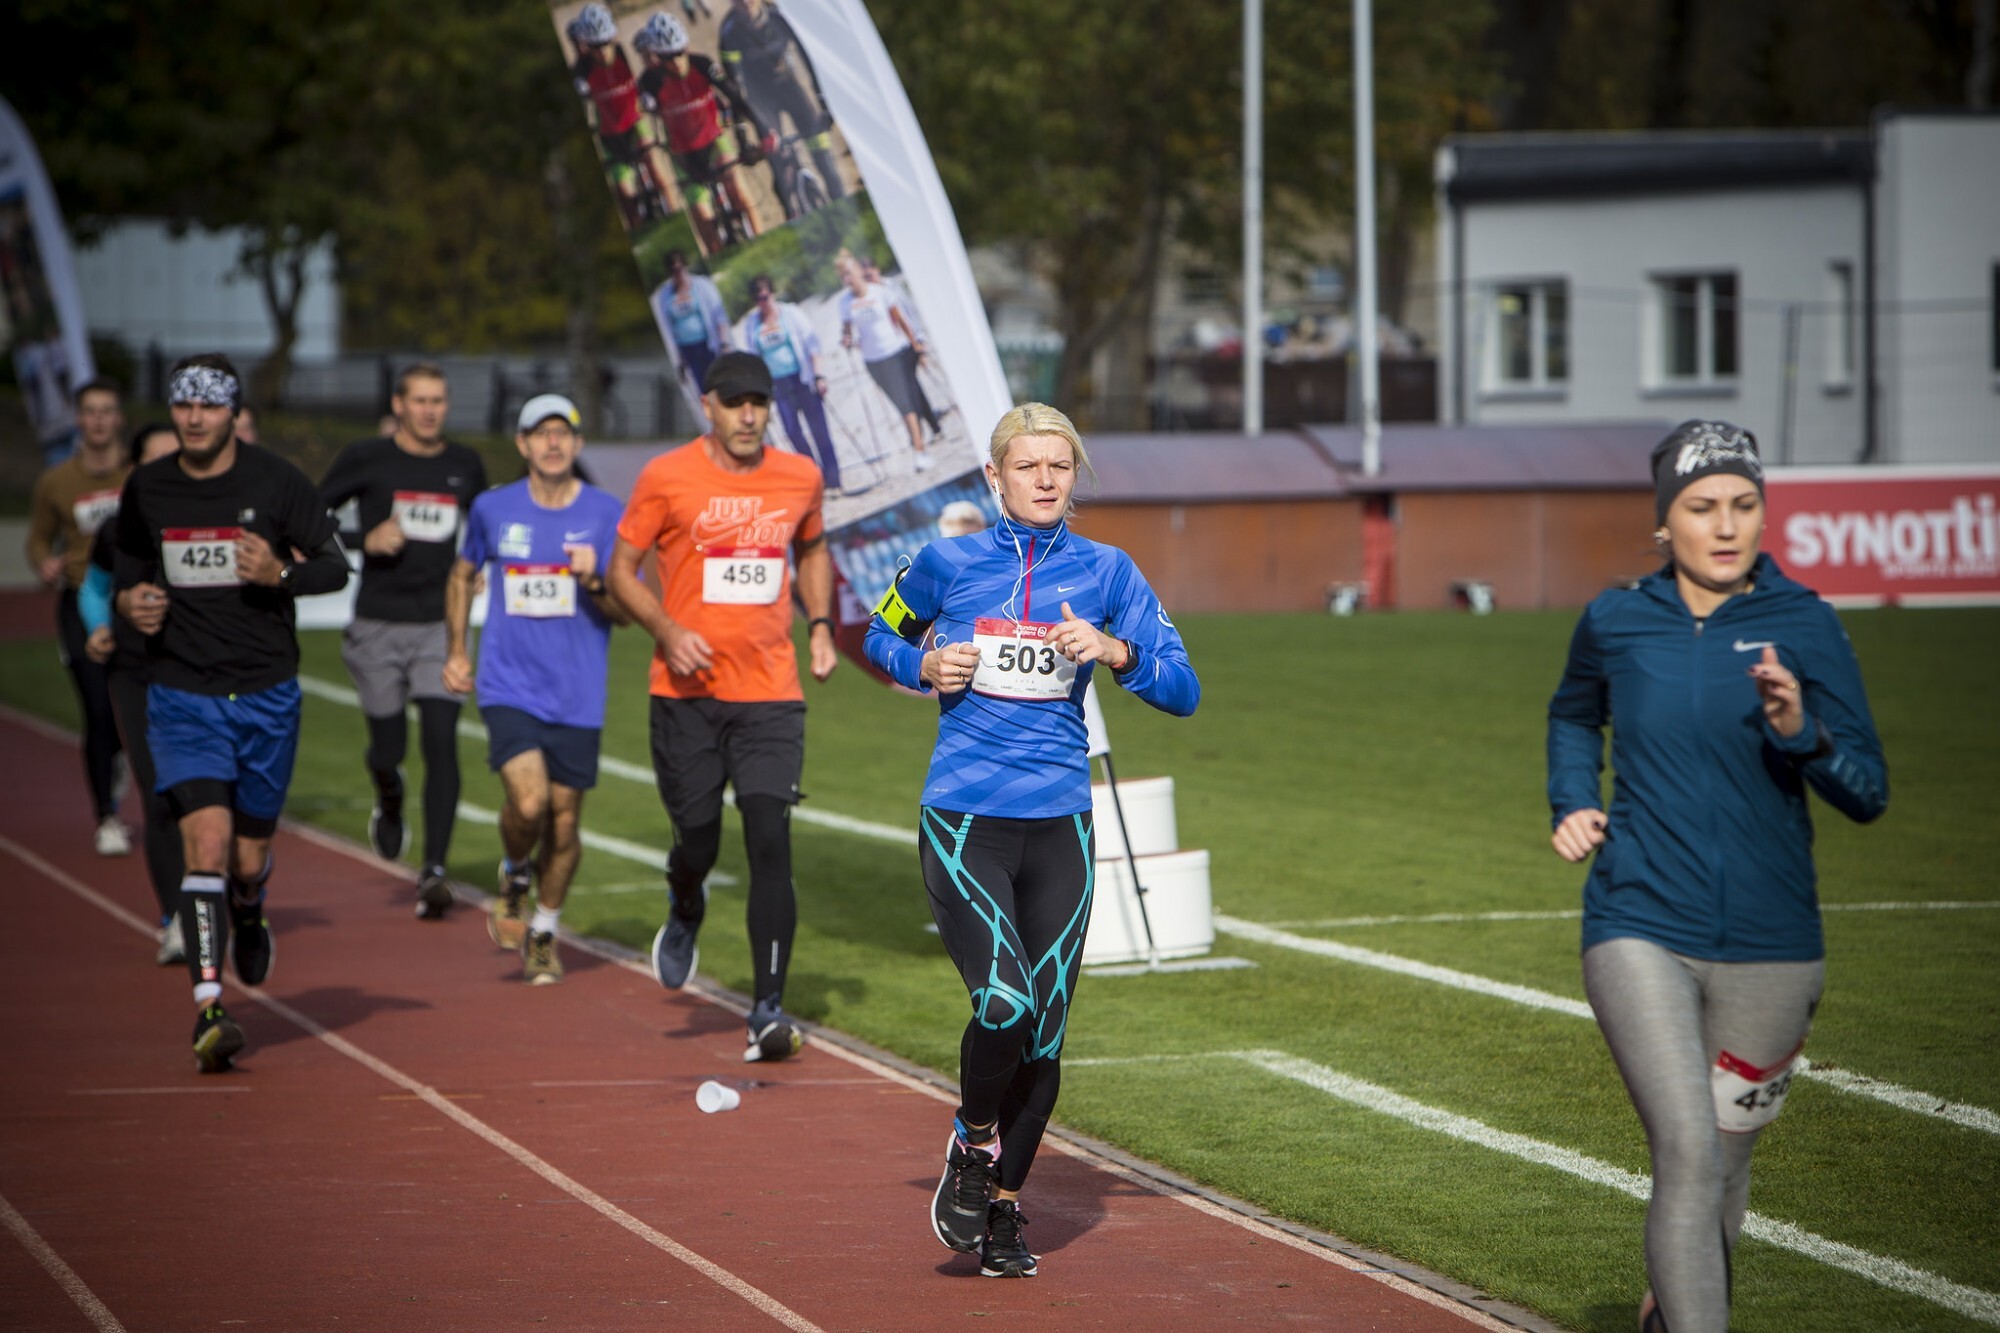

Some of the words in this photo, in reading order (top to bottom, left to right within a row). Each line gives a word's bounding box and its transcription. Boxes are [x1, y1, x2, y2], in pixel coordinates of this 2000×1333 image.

[706, 496, 764, 522] JUST
[180, 545, 228, 568] 425
[723, 564, 766, 585] 458
[519, 580, 557, 599] 453
[997, 644, 1056, 676] 503
